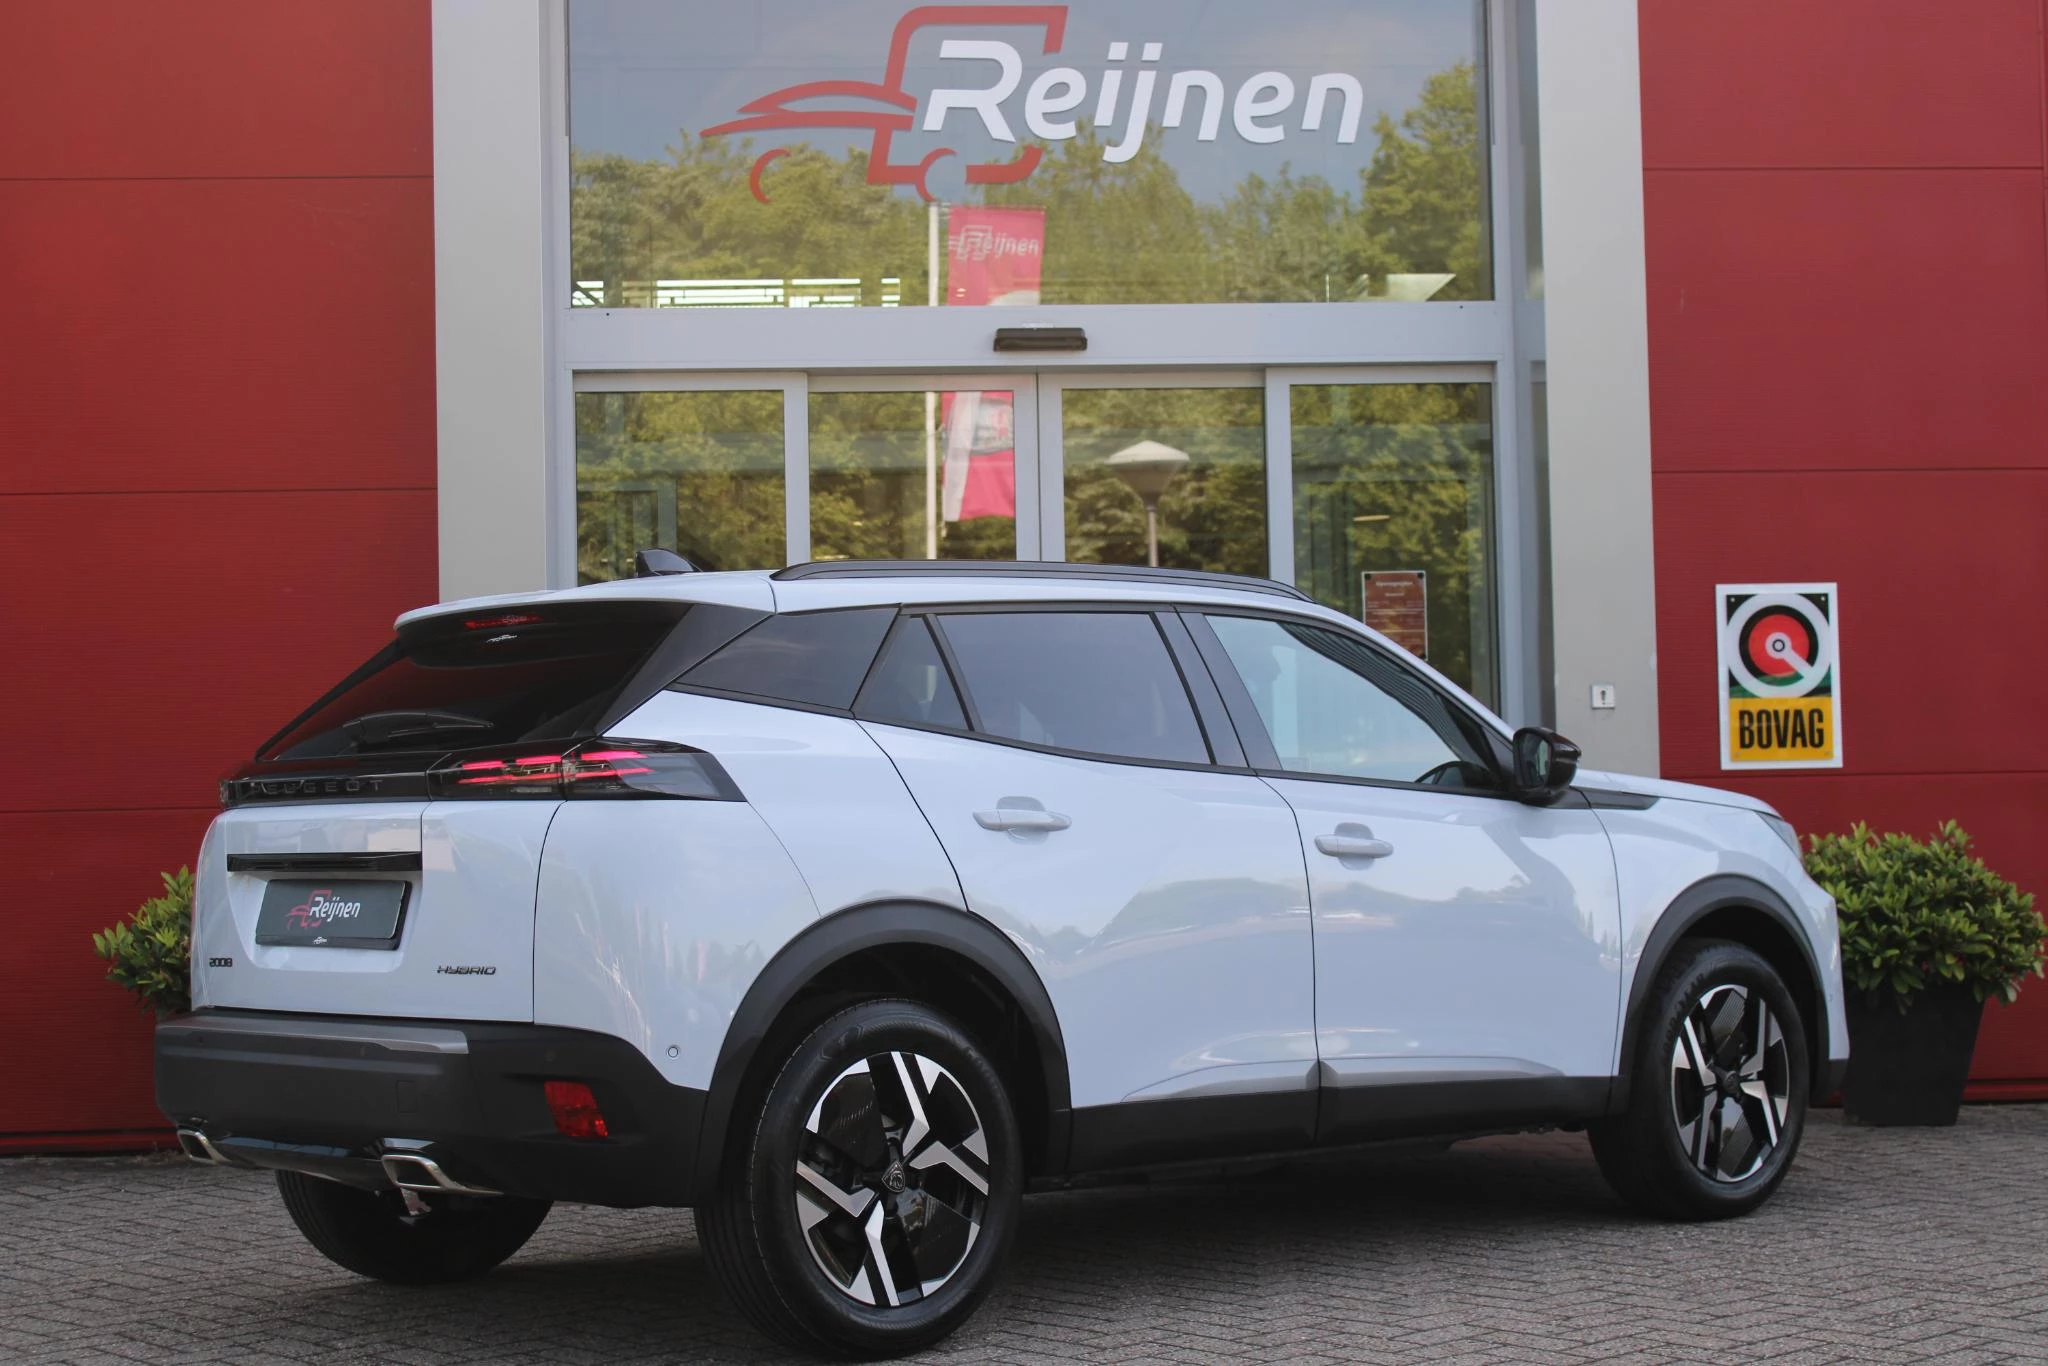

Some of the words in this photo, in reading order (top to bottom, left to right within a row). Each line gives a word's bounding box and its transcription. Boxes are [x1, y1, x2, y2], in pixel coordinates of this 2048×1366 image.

[922, 39, 1364, 164] Reijnen
[1738, 708, 1825, 750] BOVAG
[309, 896, 361, 922] Reijnen
[208, 957, 234, 969] 2008
[436, 964, 498, 977] HYBRID
